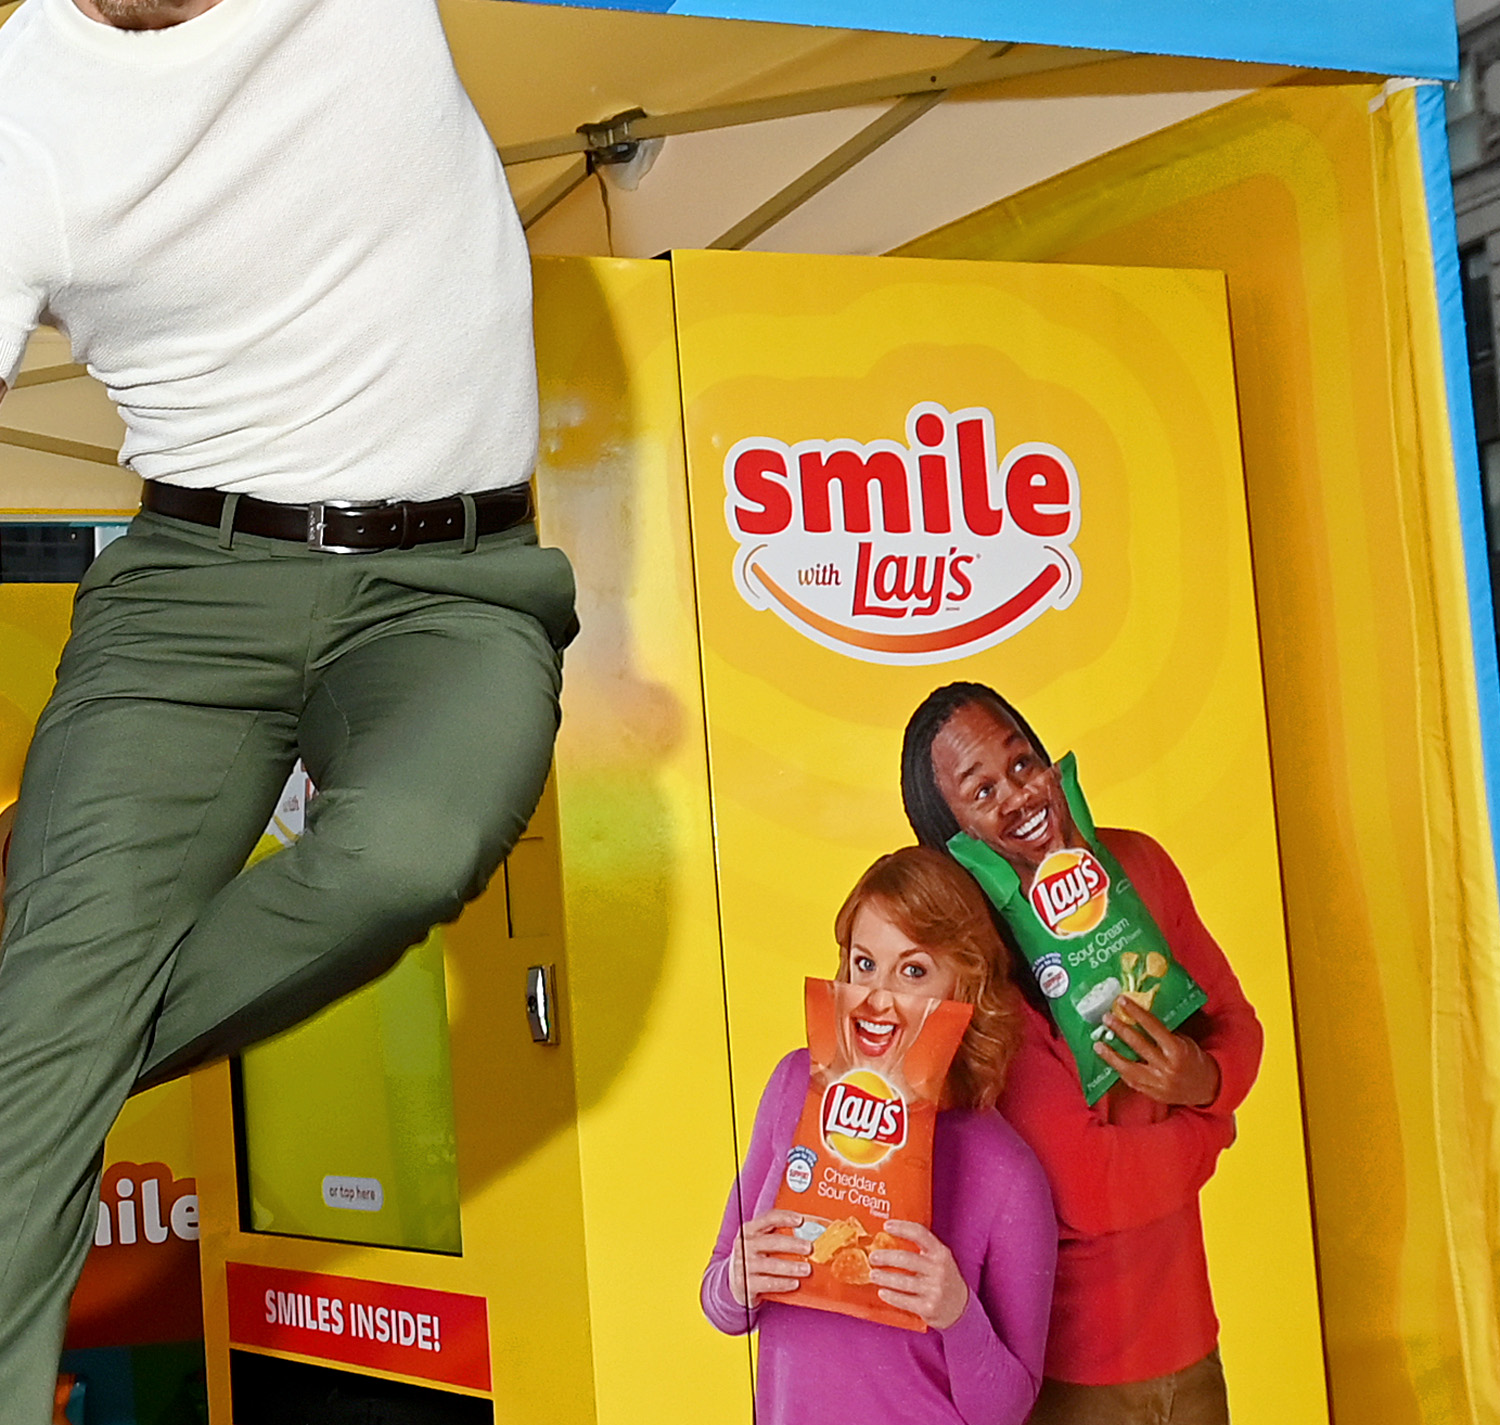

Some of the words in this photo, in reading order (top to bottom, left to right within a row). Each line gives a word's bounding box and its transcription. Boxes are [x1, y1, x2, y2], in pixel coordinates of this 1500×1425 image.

[733, 413, 1072, 537] smile
[797, 563, 841, 587] with
[852, 541, 974, 618] Lay's
[1036, 859, 1099, 927] Lay's
[1068, 940, 1095, 967] Sour
[1095, 918, 1130, 947] Cream
[1096, 936, 1128, 963] Onion
[826, 1085, 901, 1140] Lay's
[329, 1186, 339, 1199] or
[339, 1186, 355, 1202] tap
[356, 1186, 376, 1200] here
[818, 1182, 846, 1201] Sour
[848, 1189, 891, 1212] Cream
[824, 1167, 877, 1191] Cheddar
[878, 1182, 887, 1195] &
[265, 1289, 345, 1336] SMILES
[350, 1302, 441, 1353] INSIDE!
